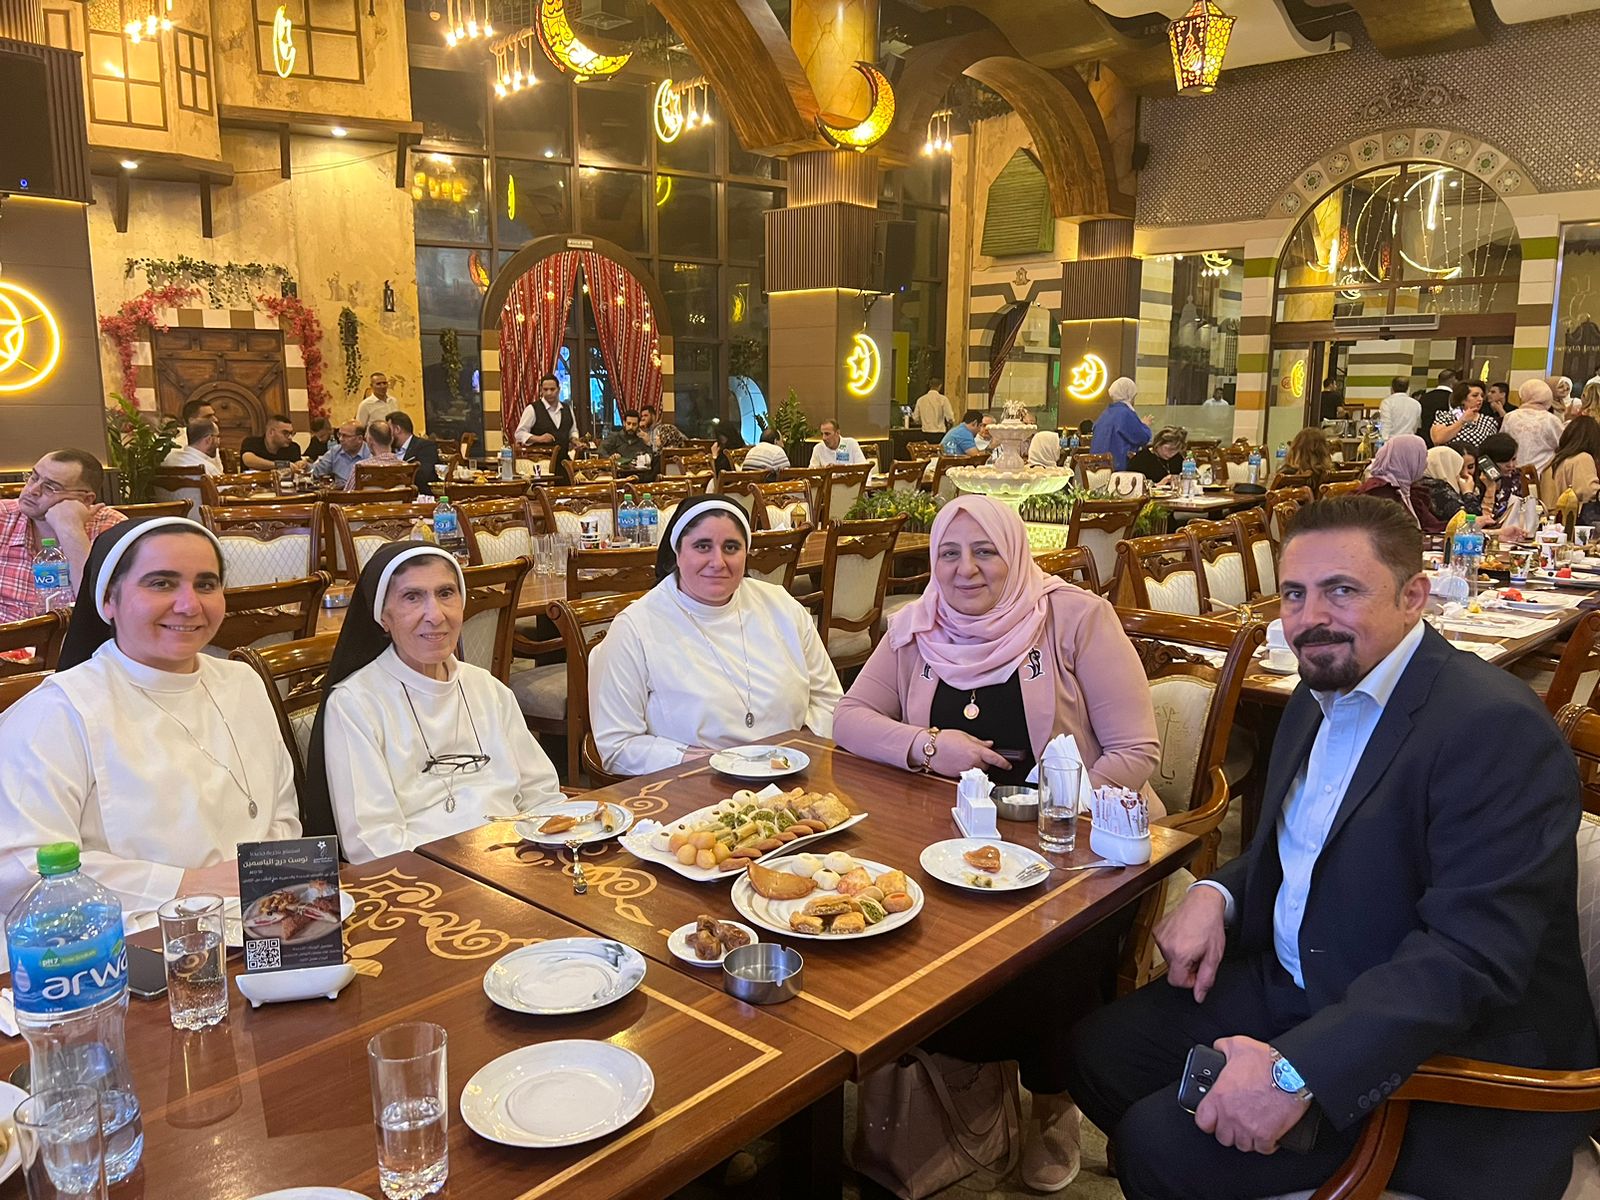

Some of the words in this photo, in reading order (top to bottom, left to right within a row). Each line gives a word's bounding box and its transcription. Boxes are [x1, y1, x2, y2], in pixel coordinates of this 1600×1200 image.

[242, 859, 274, 868] الياسمين
[274, 859, 287, 867] درج
[287, 856, 308, 864] توست
[42, 946, 128, 1000] arwa
